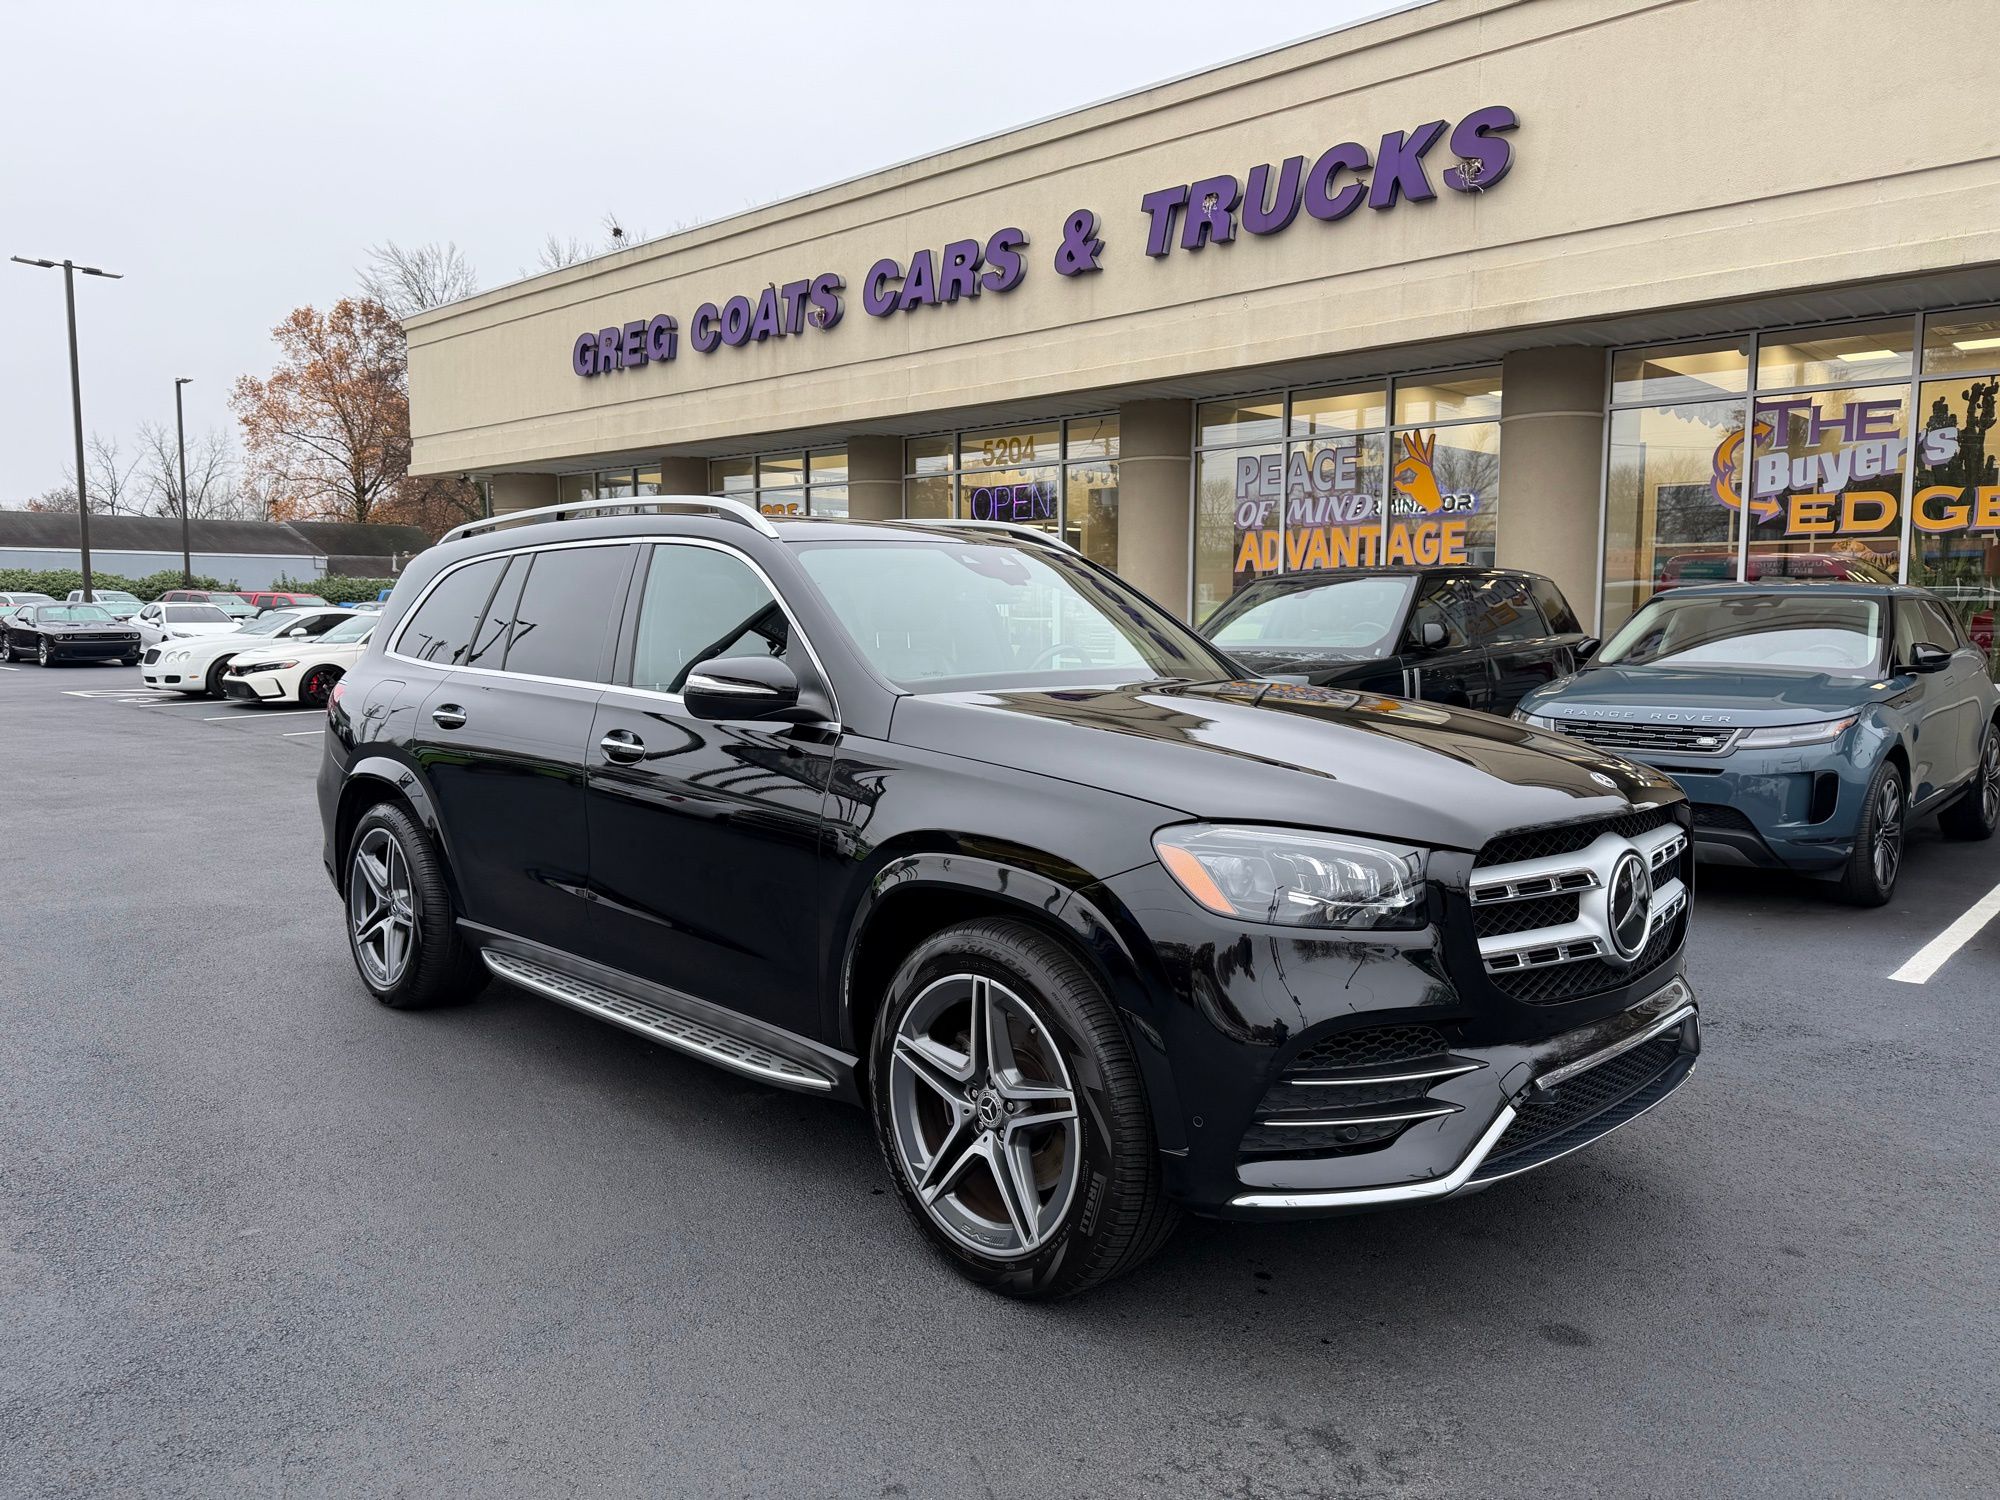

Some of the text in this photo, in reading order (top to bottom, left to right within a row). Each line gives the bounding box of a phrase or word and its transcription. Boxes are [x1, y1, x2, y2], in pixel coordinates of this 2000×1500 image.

[573, 105, 1521, 377] GREG COATS CARS & TRUCKS
[1755, 397, 1903, 451] THE
[982, 435, 1037, 467] 5204
[1236, 446, 1361, 499] PEACE
[1754, 426, 1961, 499] Buyer's
[972, 482, 1051, 520] OPEN
[1236, 493, 1374, 530] OF MIND
[1234, 520, 1468, 573] ADVANTAGE
[1563, 707, 1732, 723] RANGE ROVER
[1079, 1170, 1108, 1237] PIRELLI
